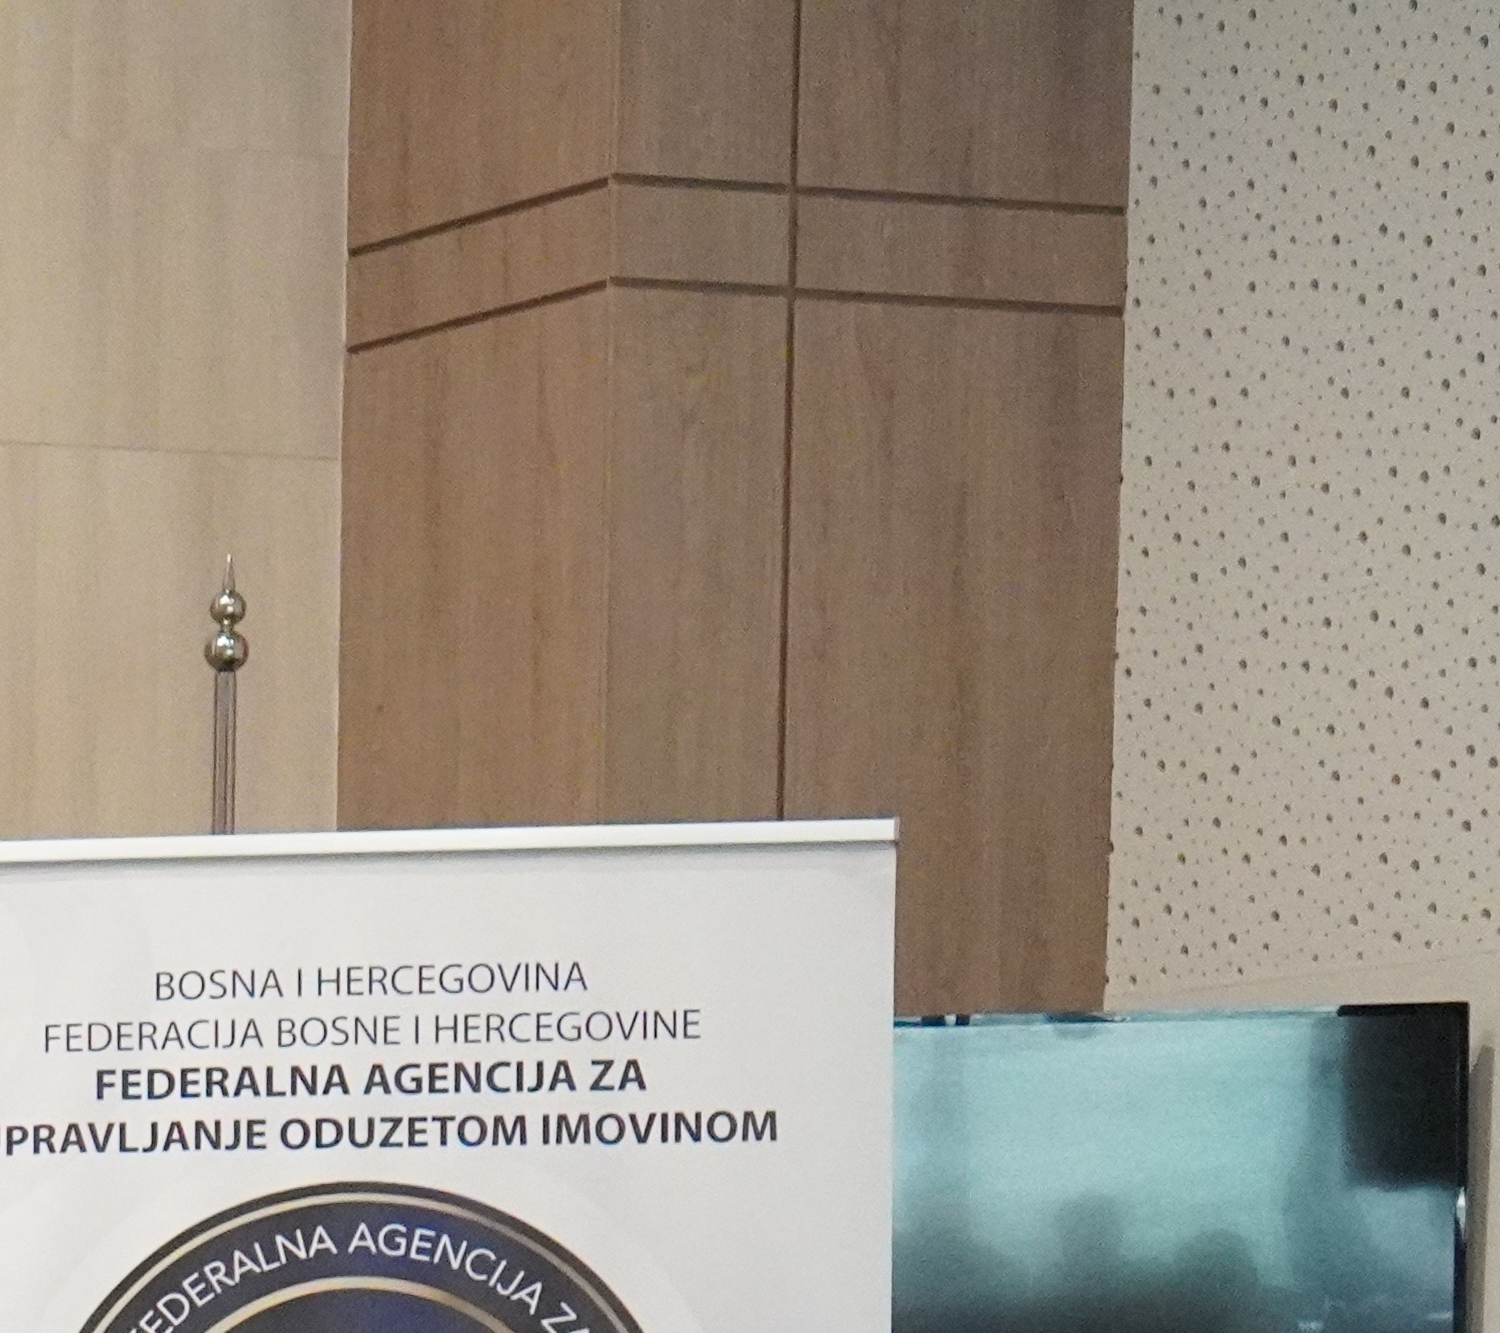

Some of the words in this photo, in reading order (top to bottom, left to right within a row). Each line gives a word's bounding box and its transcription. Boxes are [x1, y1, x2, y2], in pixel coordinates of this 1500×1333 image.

[155, 968, 284, 1001] BOSNA
[297, 968, 303, 997] I
[317, 961, 588, 997] HERCEGOVINA
[44, 1018, 264, 1053] FEDERACIJA
[277, 1015, 401, 1048] BOSNE
[414, 1015, 420, 1045] I
[434, 1009, 701, 1044] HERCEGOVINE
[96, 1063, 350, 1101] FEDERALNA
[363, 1059, 577, 1096] AGENCIJA
[589, 1058, 647, 1092] ZA
[279, 1114, 528, 1151] ODUZETOM
[542, 1110, 778, 1146] IMOVINOM
[348, 1222, 543, 1315] AGENCIJA
